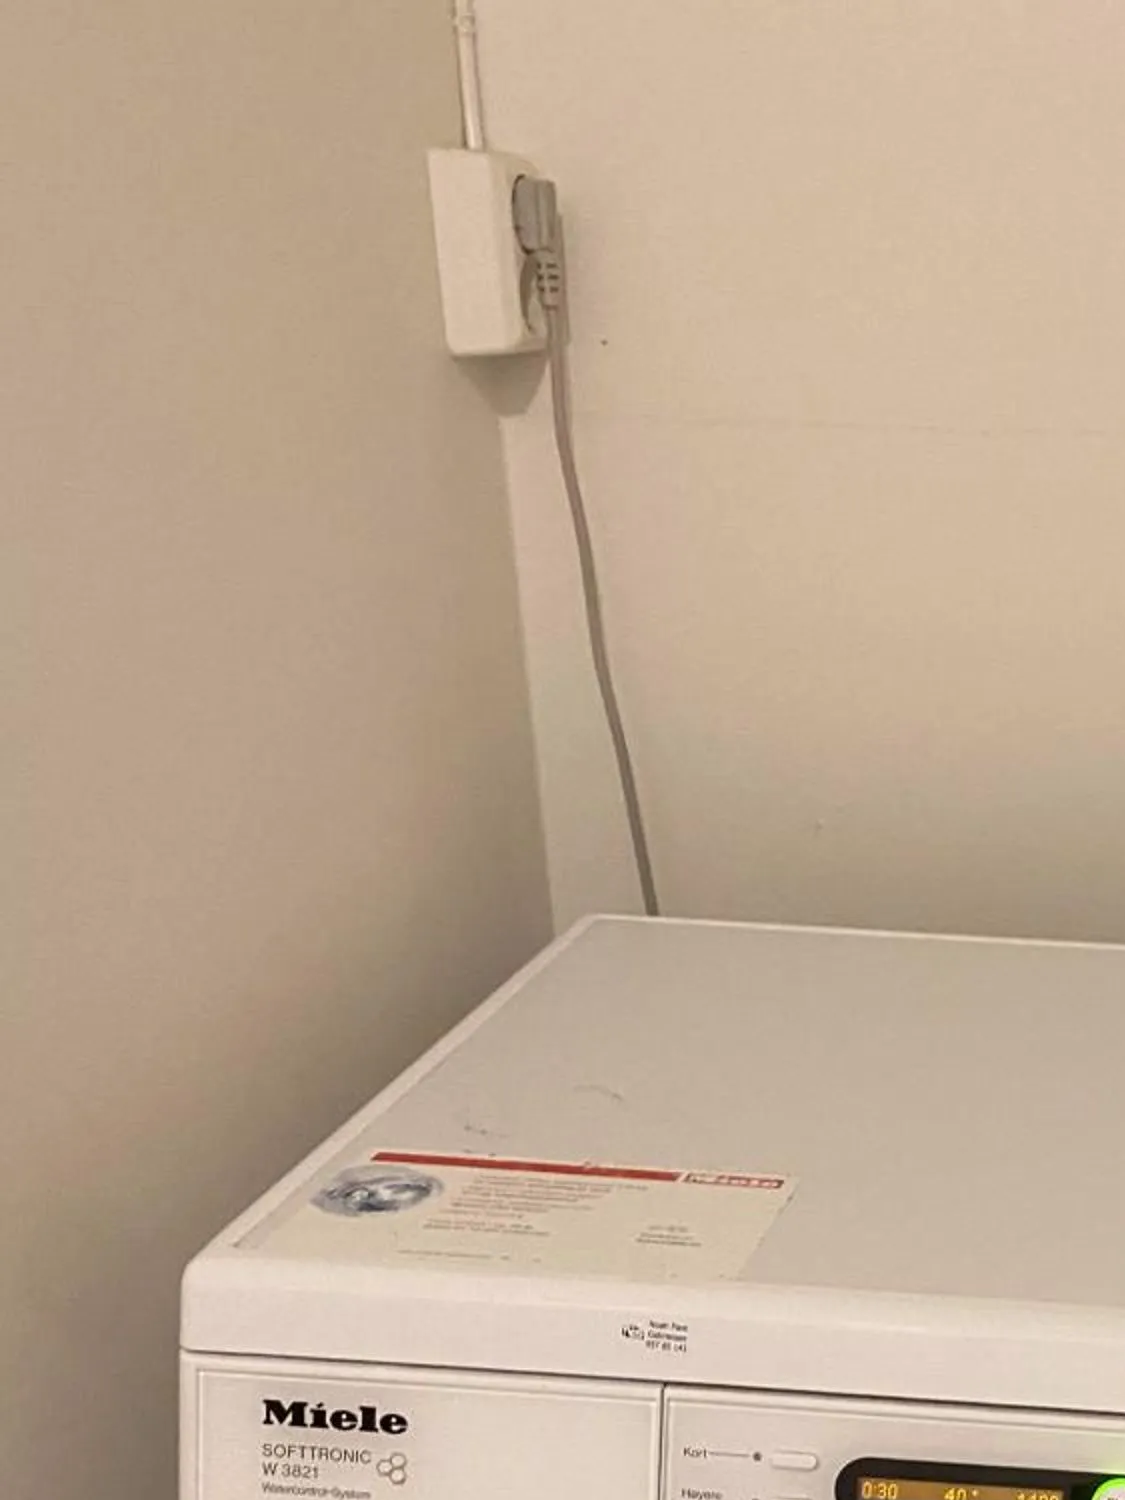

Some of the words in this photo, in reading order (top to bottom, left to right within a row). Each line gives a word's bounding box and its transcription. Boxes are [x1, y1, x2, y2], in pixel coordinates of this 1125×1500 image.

[262, 1399, 409, 1435] Miele
[262, 1443, 372, 1464] SOFTTRONIC
[683, 1447, 708, 1459] Kort
[262, 1462, 279, 1477] W
[281, 1464, 320, 1479] 3821
[861, 1481, 898, 1500] 0:30
